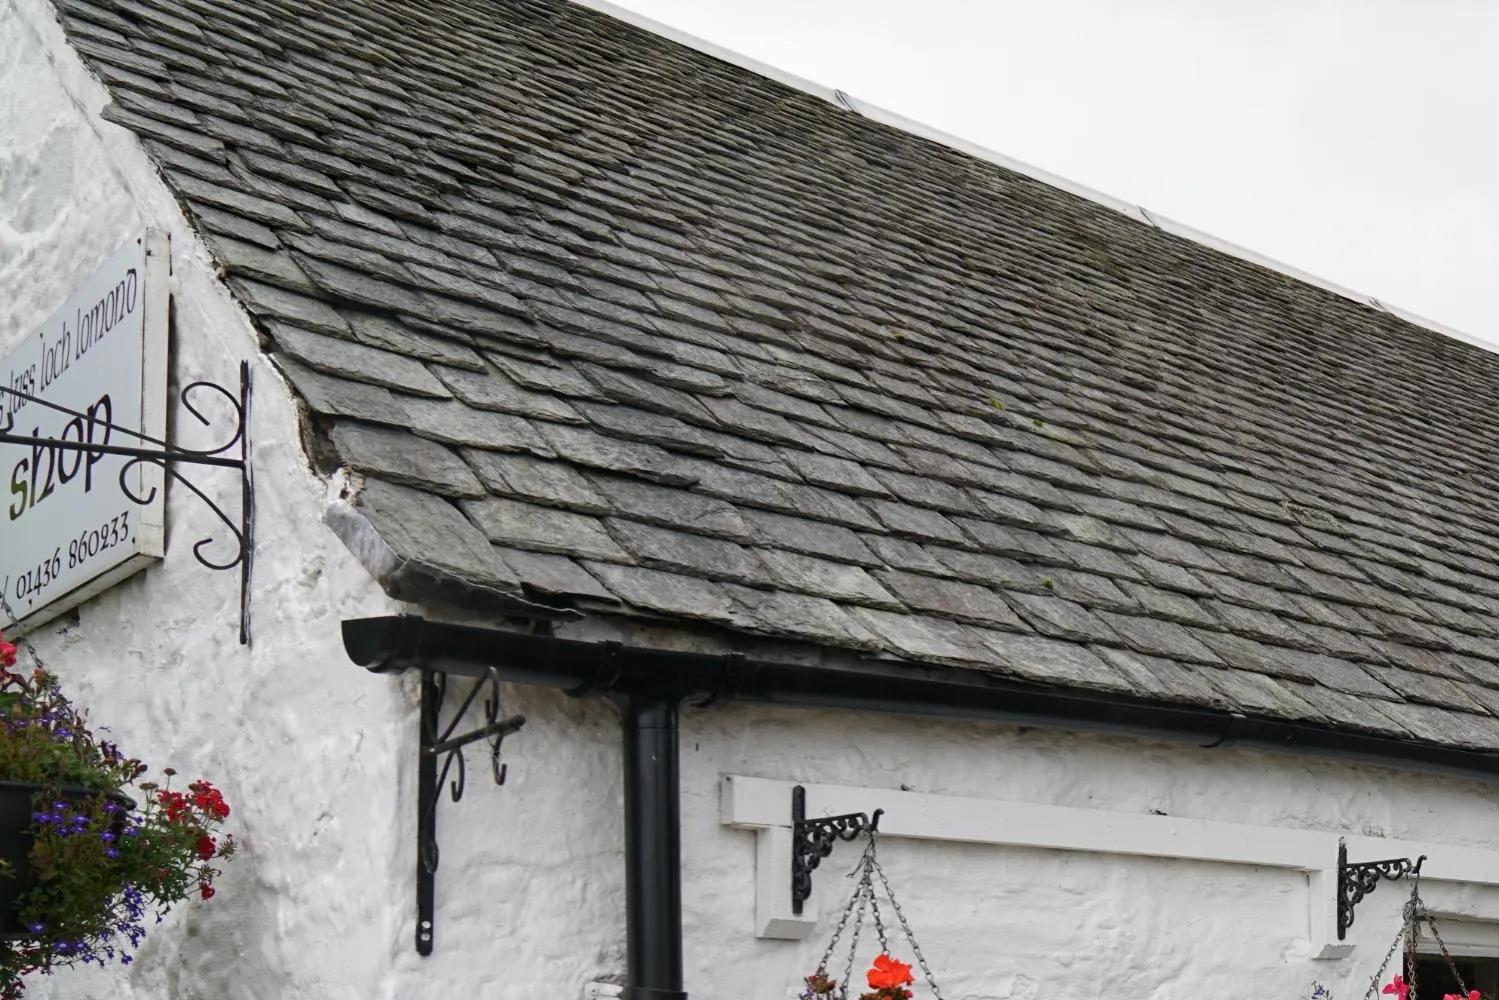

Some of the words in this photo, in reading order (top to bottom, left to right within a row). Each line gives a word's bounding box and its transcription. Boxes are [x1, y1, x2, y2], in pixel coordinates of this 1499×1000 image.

[41, 321, 71, 392] loch
[76, 268, 137, 361] lomond
[9, 394, 112, 521] shop
[16, 547, 60, 599] 01436
[69, 511, 129, 568] 860233
